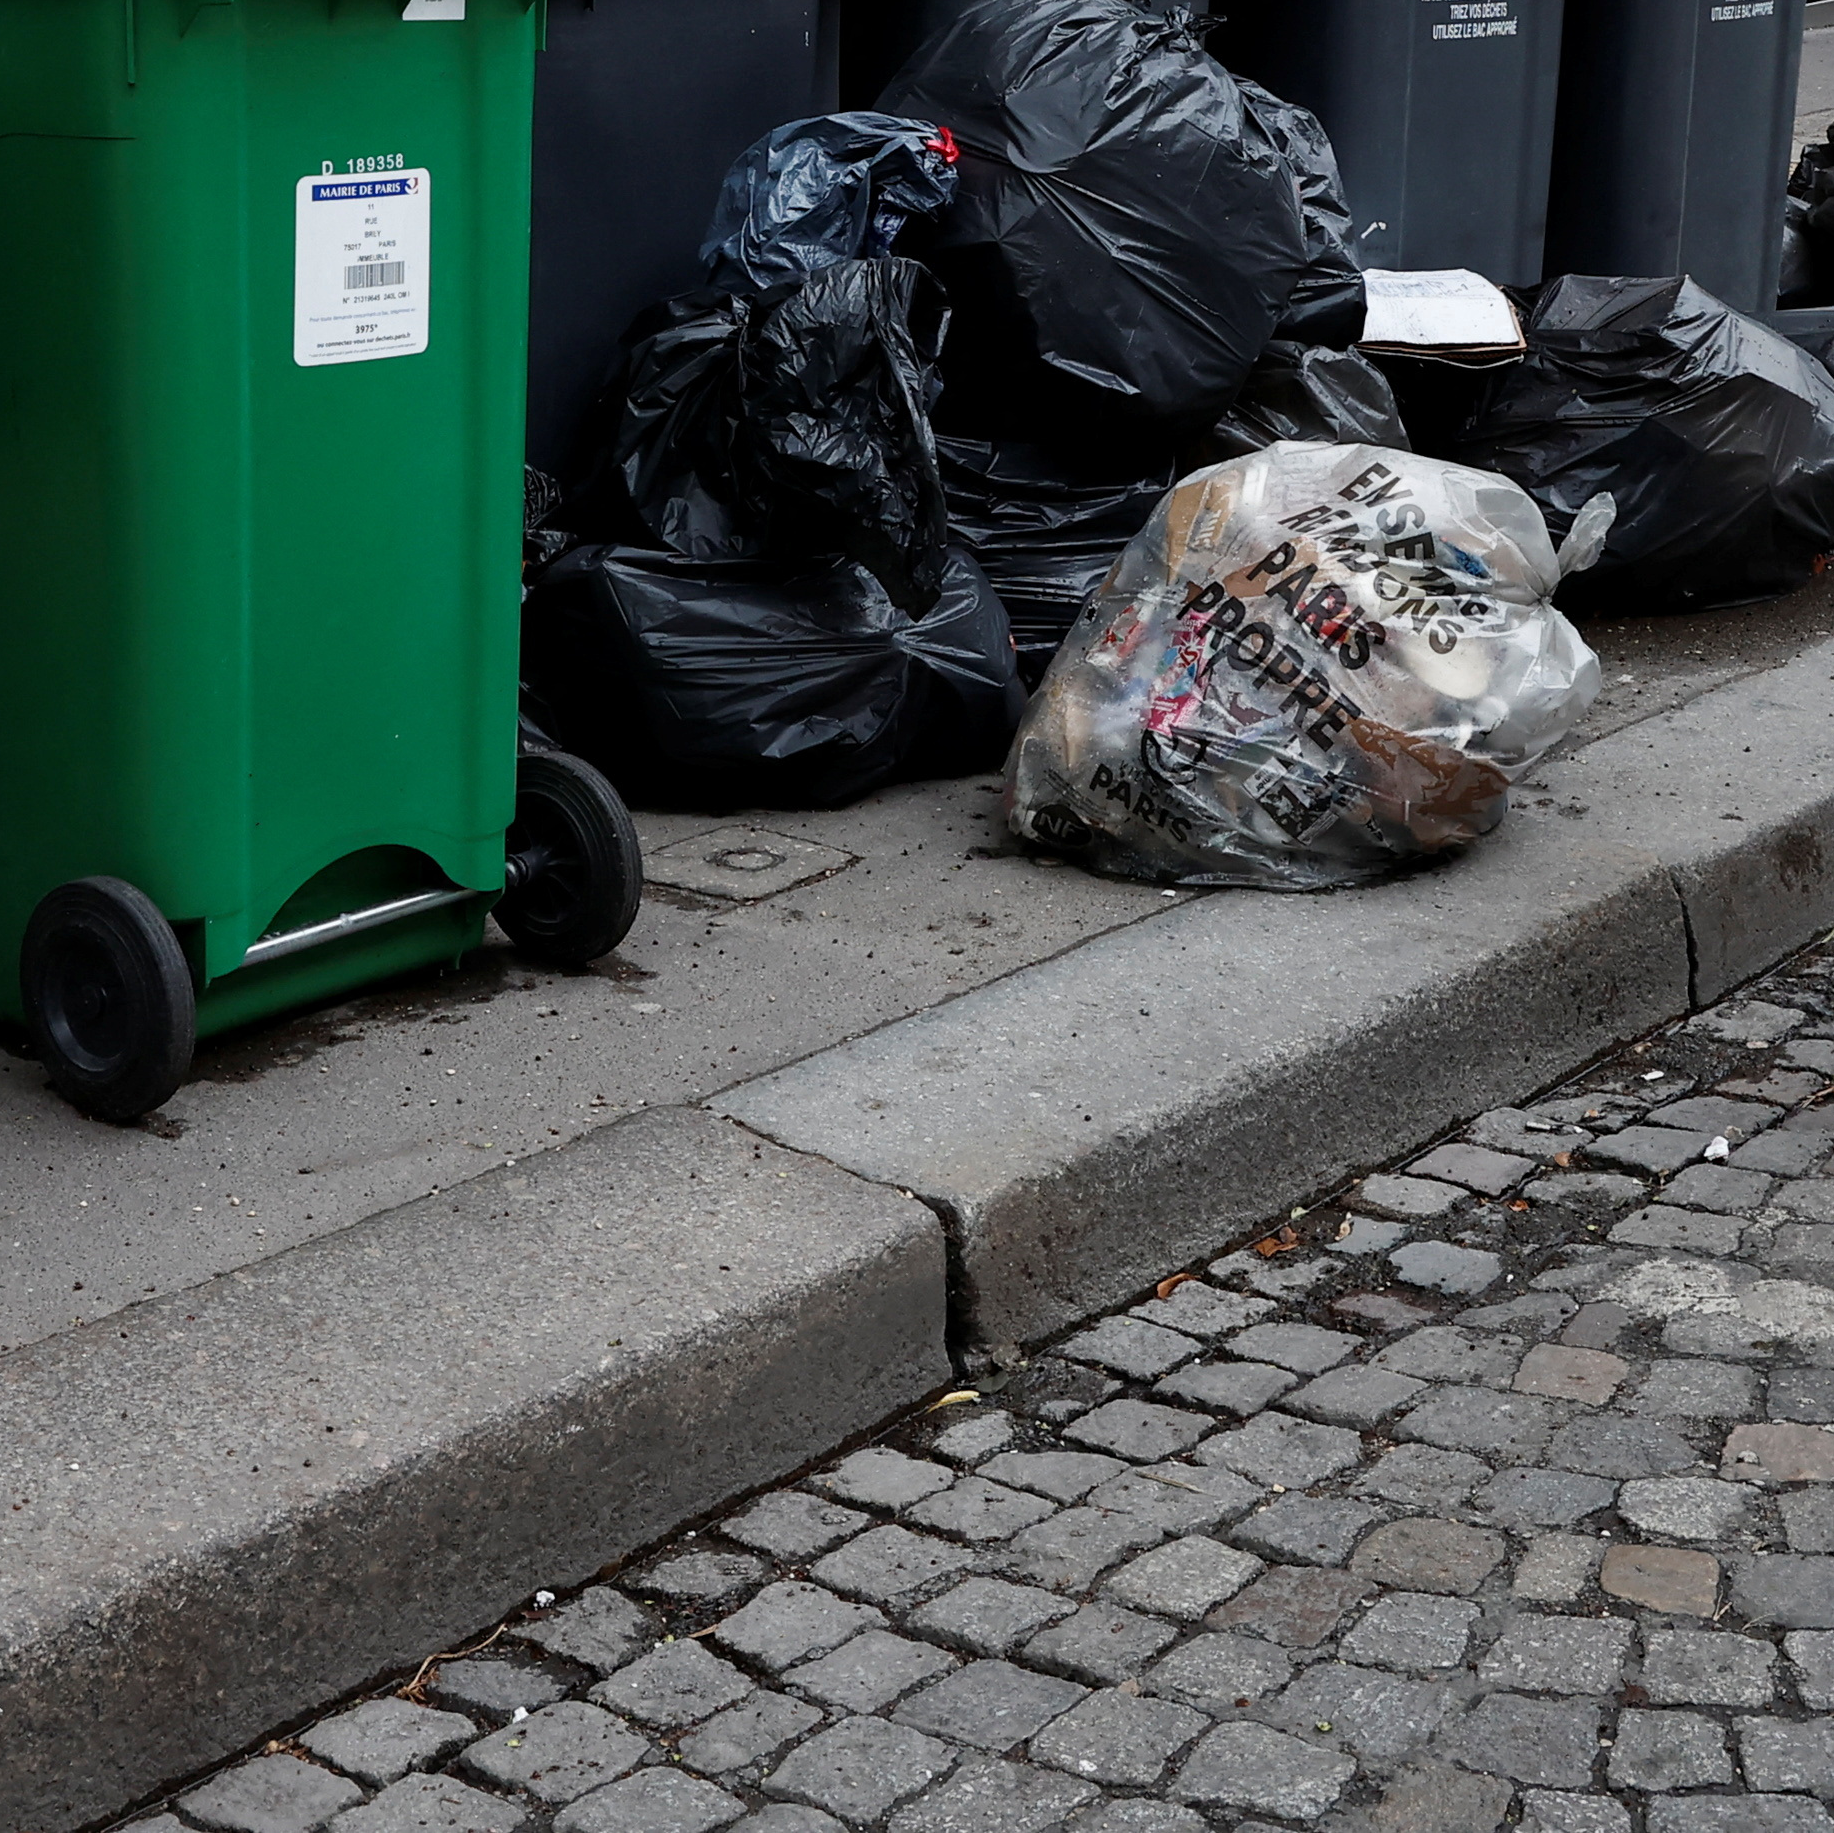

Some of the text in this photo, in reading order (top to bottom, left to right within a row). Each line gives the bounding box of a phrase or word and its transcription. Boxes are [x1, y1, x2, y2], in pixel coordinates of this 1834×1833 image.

[1450, 0, 1508, 20] TRIEZ VOS DÉCHETS
[1432, 15, 1517, 40] UTILISEZ LE BAC APPROPRIÉ
[322, 153, 404, 176] D 189358
[319, 182, 401, 198] MAIRIE DE PARIS
[365, 217, 378, 225] RUE
[378, 240, 397, 248] PARIS
[1246, 541, 1386, 670] PARIS
[1176, 581, 1361, 752] PROPRE
[1089, 762, 1193, 844] PARIS
